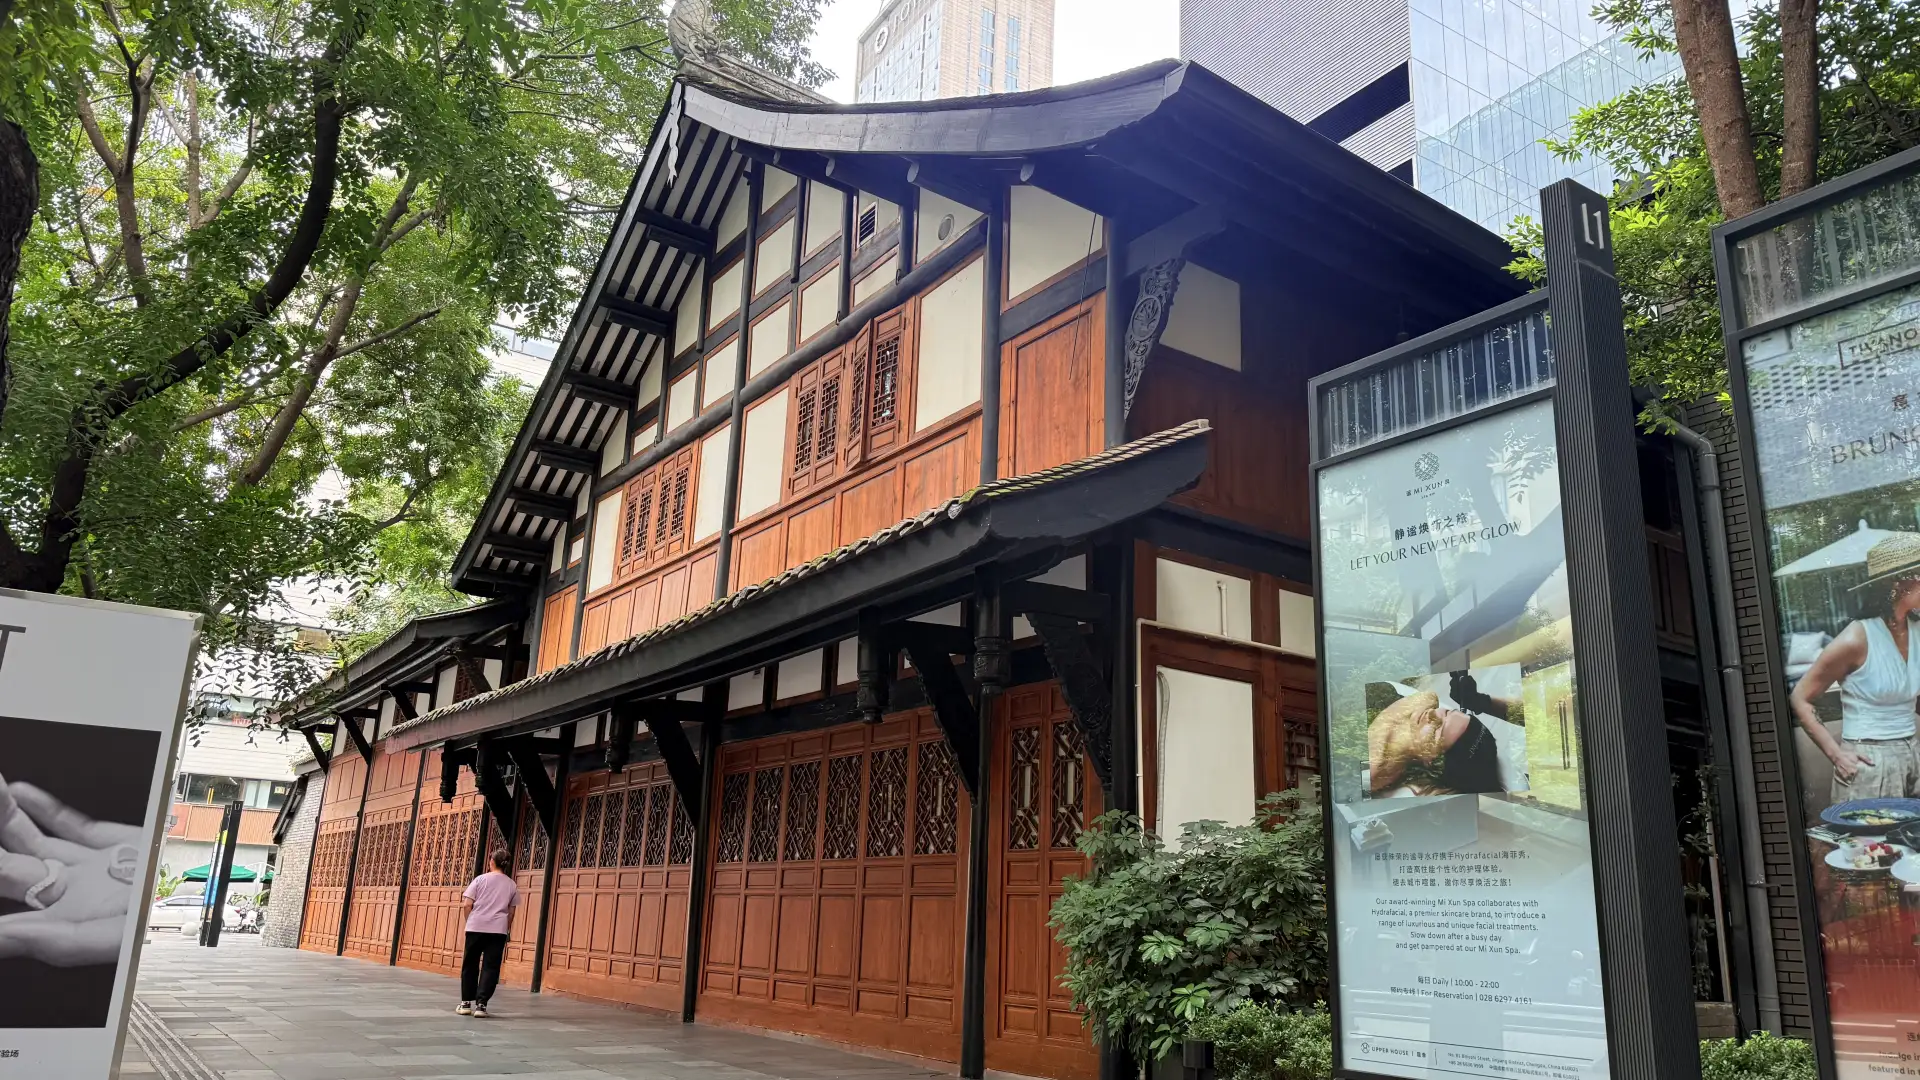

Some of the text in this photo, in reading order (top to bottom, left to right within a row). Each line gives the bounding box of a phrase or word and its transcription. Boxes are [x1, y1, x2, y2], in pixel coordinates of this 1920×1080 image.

[1581, 203, 1605, 250] L1
[1425, 480, 1443, 492] XUN
[1350, 520, 1522, 571] LET YOUR NEW YEAR GLOW
[1375, 897, 1387, 905] Our
[1388, 898, 1436, 907] award-winning
[1437, 898, 1446, 906] Mi
[1462, 899, 1476, 908] Spa
[1477, 899, 1521, 907] collaborates
[1522, 899, 1539, 907] with
[1371, 908, 1408, 917] Hydrafacial,
[1414, 909, 1440, 918] premier
[1440, 910, 1469, 918] skincare
[1470, 911, 1493, 919] brand,
[1494, 911, 1503, 919] to
[1504, 911, 1540, 919] introduce
[1378, 920, 1397, 929] range
[1405, 920, 1436, 928] luxurious
[1450, 922, 1475, 930] unique
[1475, 922, 1495, 930] facial
[1496, 923, 1539, 931] treatments.
[1410, 931, 1426, 939] Slow
[1427, 931, 1446, 939] down
[1447, 932, 1464, 940] after
[1471, 933, 1488, 942] busy
[1489, 934, 1502, 943] day
[1395, 941, 1408, 949] and
[1408, 942, 1420, 950] get
[1420, 943, 1455, 952] pampered
[1455, 944, 1464, 952] at
[1478, 945, 1487, 953] Mi
[1488, 945, 1503, 954] Xun
[1504, 946, 1521, 955] Spa.
[1417, 975, 1431, 985] 每日
[1432, 977, 1449, 987] Daily
[1454, 979, 1474, 987] 10:00
[1479, 980, 1500, 989] 22:00
[1420, 989, 1432, 997] For
[1433, 990, 1474, 1000] Reservation
[1479, 993, 1493, 1002] 028
[1494, 994, 1513, 1004] 6297
[1514, 996, 1533, 1005] 4161
[0, 1049, 19, 1058] 验场
[1371, 1046, 1389, 1054] UPPER
[1390, 1048, 1409, 1056] HOUSE
[1868, 1064, 1906, 1075] featured
[1907, 1067, 1916, 1076] in
